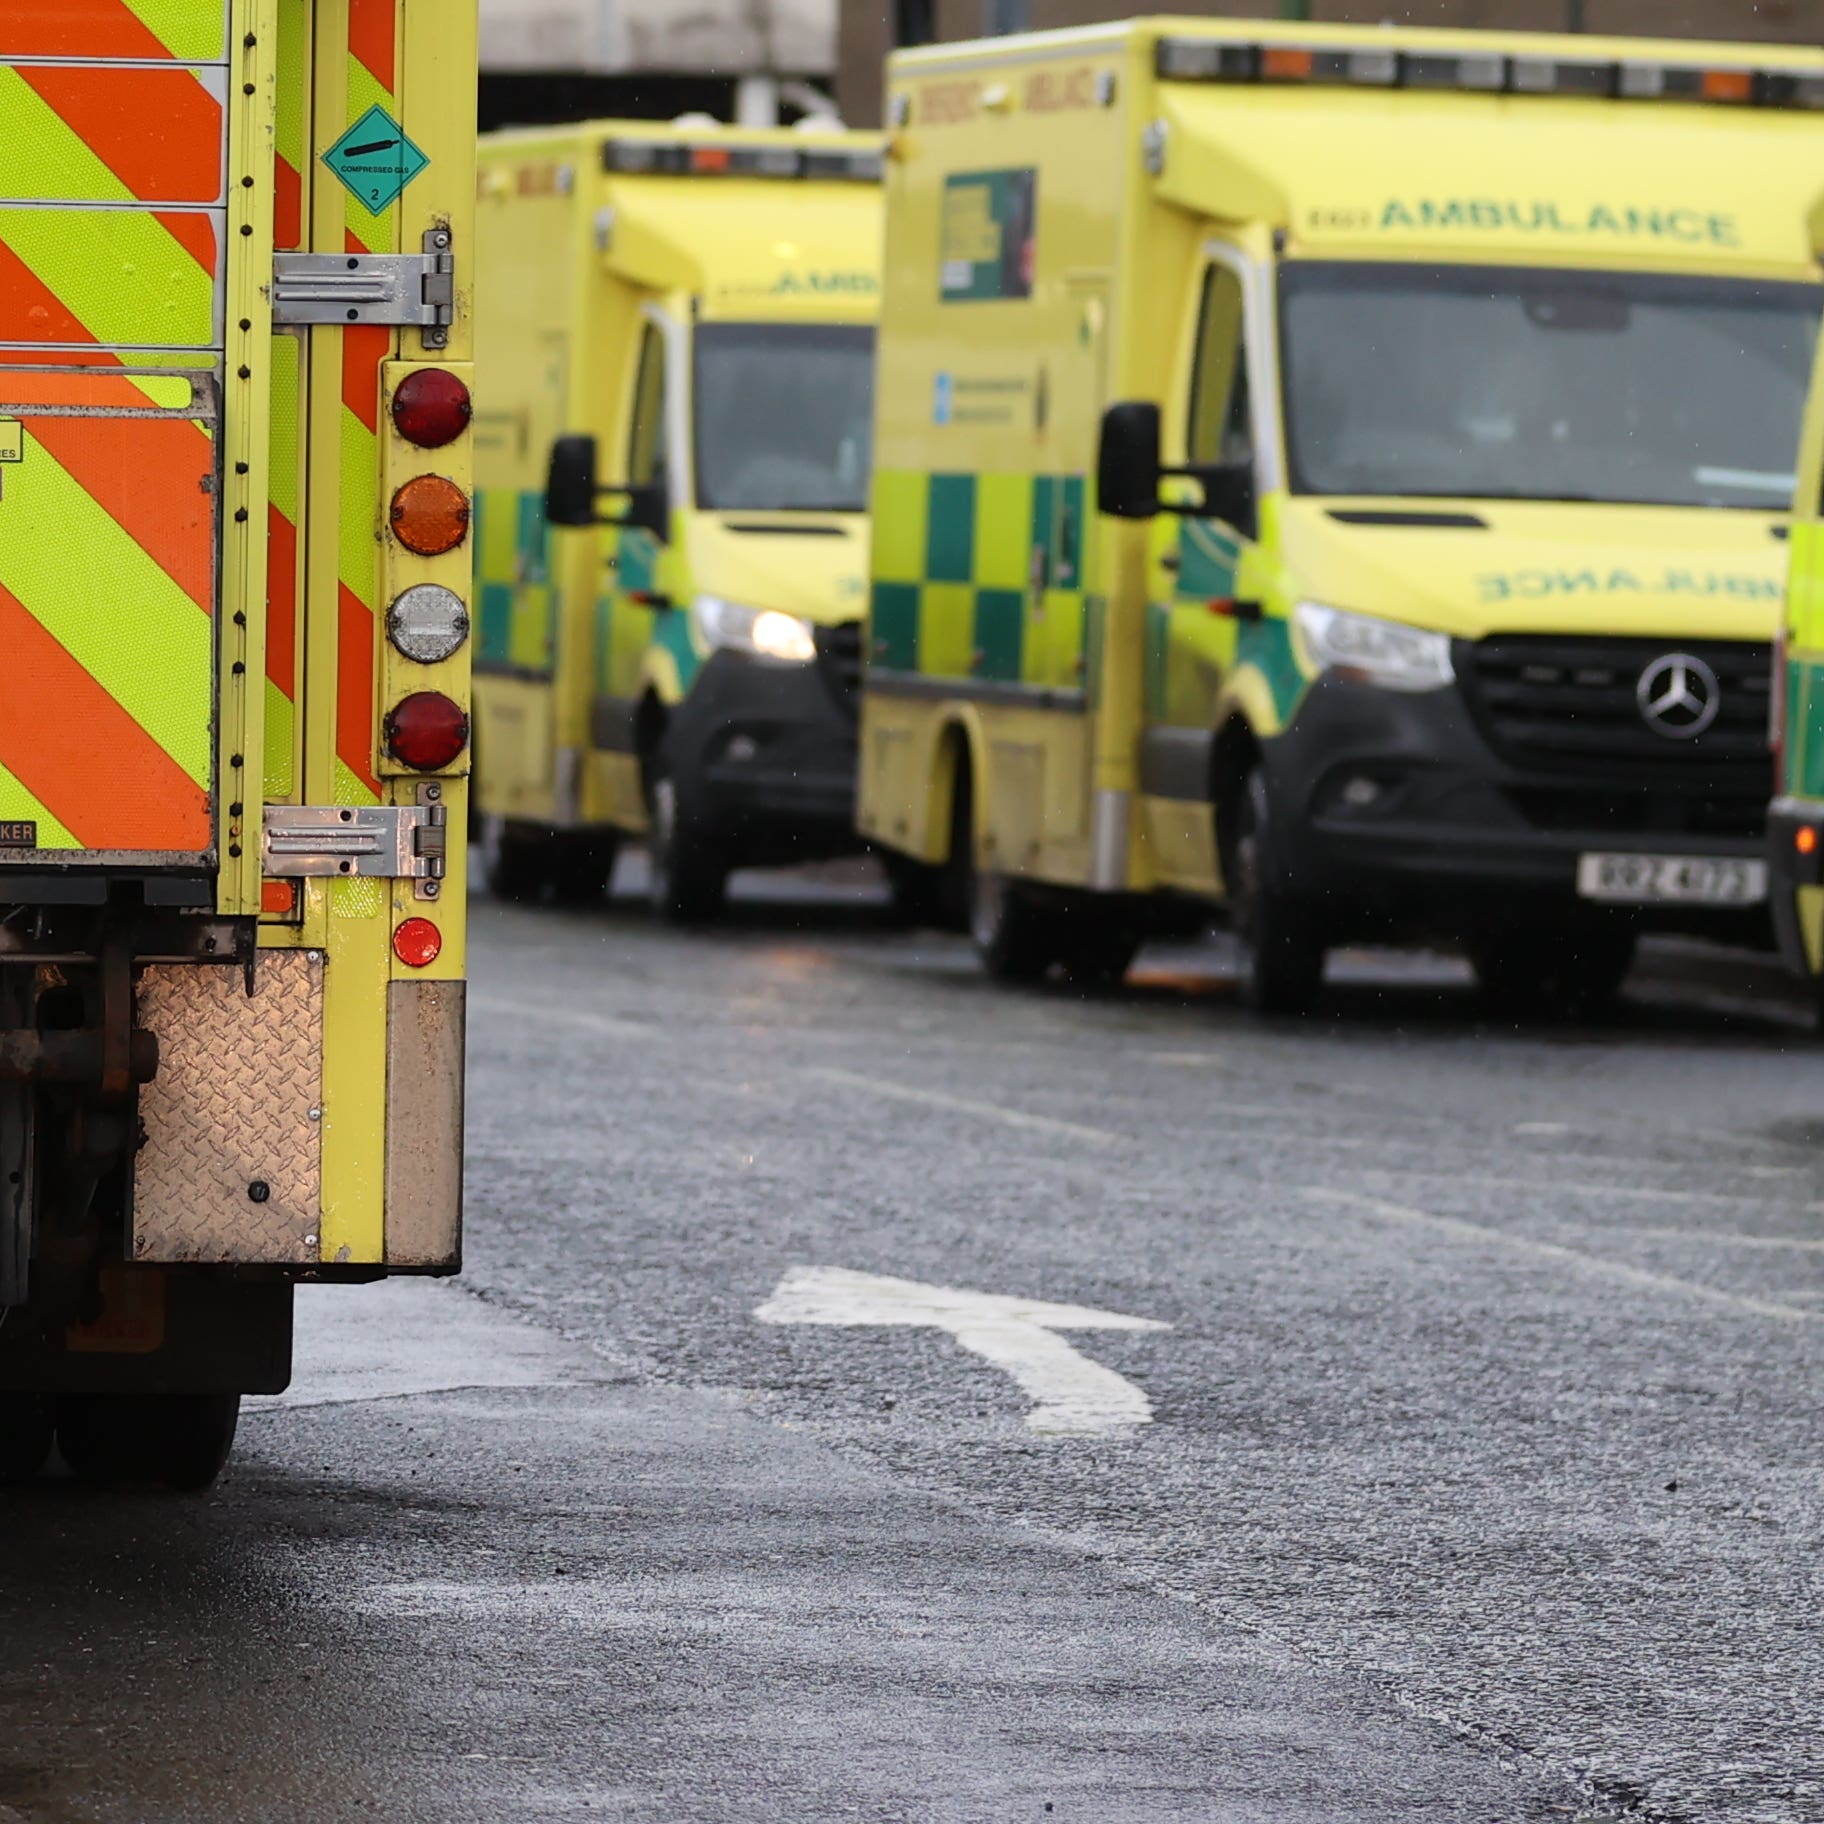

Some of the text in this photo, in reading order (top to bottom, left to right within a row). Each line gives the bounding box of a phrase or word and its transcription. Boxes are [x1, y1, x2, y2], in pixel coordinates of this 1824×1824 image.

[341, 165, 409, 174] COMPRESSED GAS
[371, 188, 380, 201] 2
[1380, 196, 1742, 248] AMBULANCE
